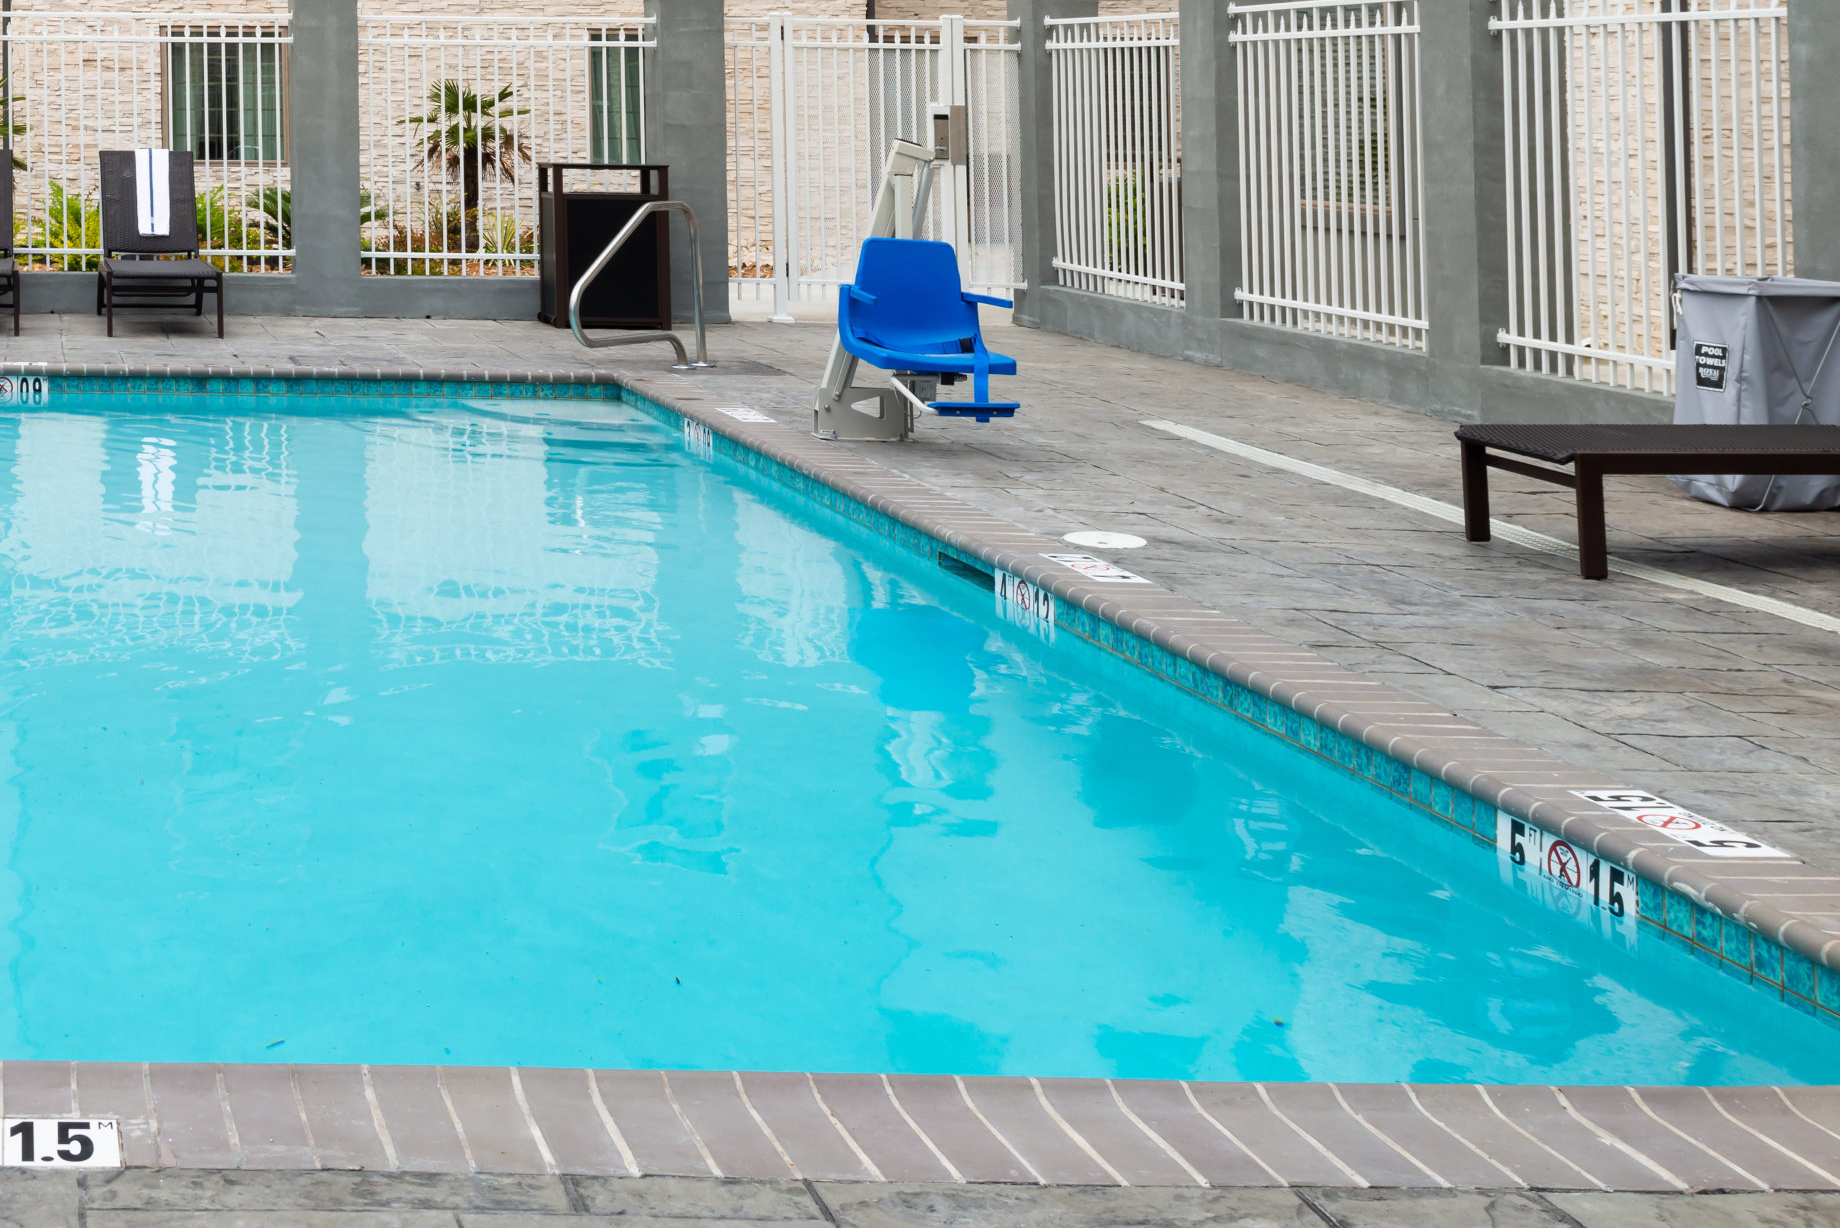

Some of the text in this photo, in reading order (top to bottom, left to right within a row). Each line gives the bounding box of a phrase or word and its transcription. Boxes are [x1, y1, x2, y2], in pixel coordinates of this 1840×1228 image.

[1695, 356, 1726, 367] TOWELS
[1701, 346, 1723, 356] POOL
[1510, 817, 1537, 865] 5 FT
[10, 1121, 113, 1162] 1.5 M
